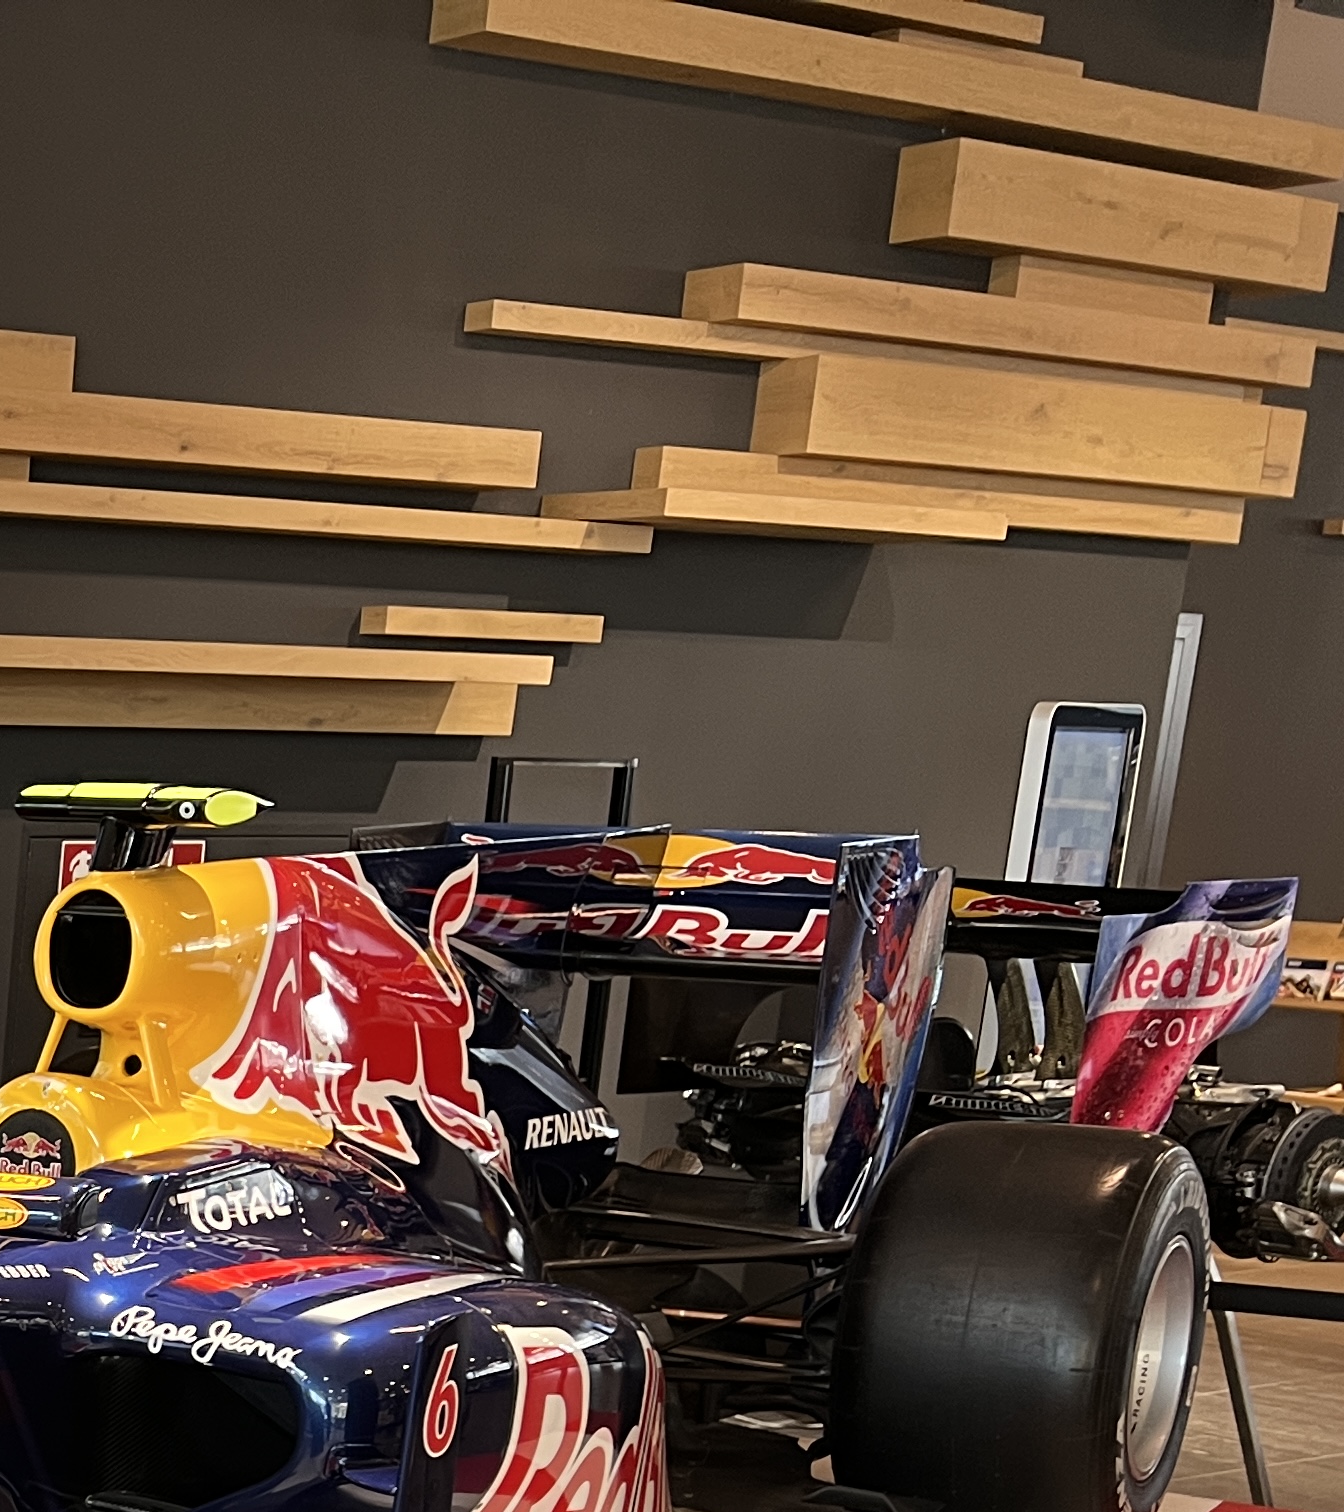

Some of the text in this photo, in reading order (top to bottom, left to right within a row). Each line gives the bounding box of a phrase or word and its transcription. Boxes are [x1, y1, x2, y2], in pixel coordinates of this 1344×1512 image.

[1111, 932, 1202, 1002] Red
[1145, 1016, 1215, 1048] COLA
[524, 1107, 610, 1151] RENAULT
[31, 1161, 62, 1178] Bull
[177, 1170, 292, 1234] TOTAL
[110, 1305, 303, 1370] Pepe Jeans
[423, 1343, 459, 1458] 6
